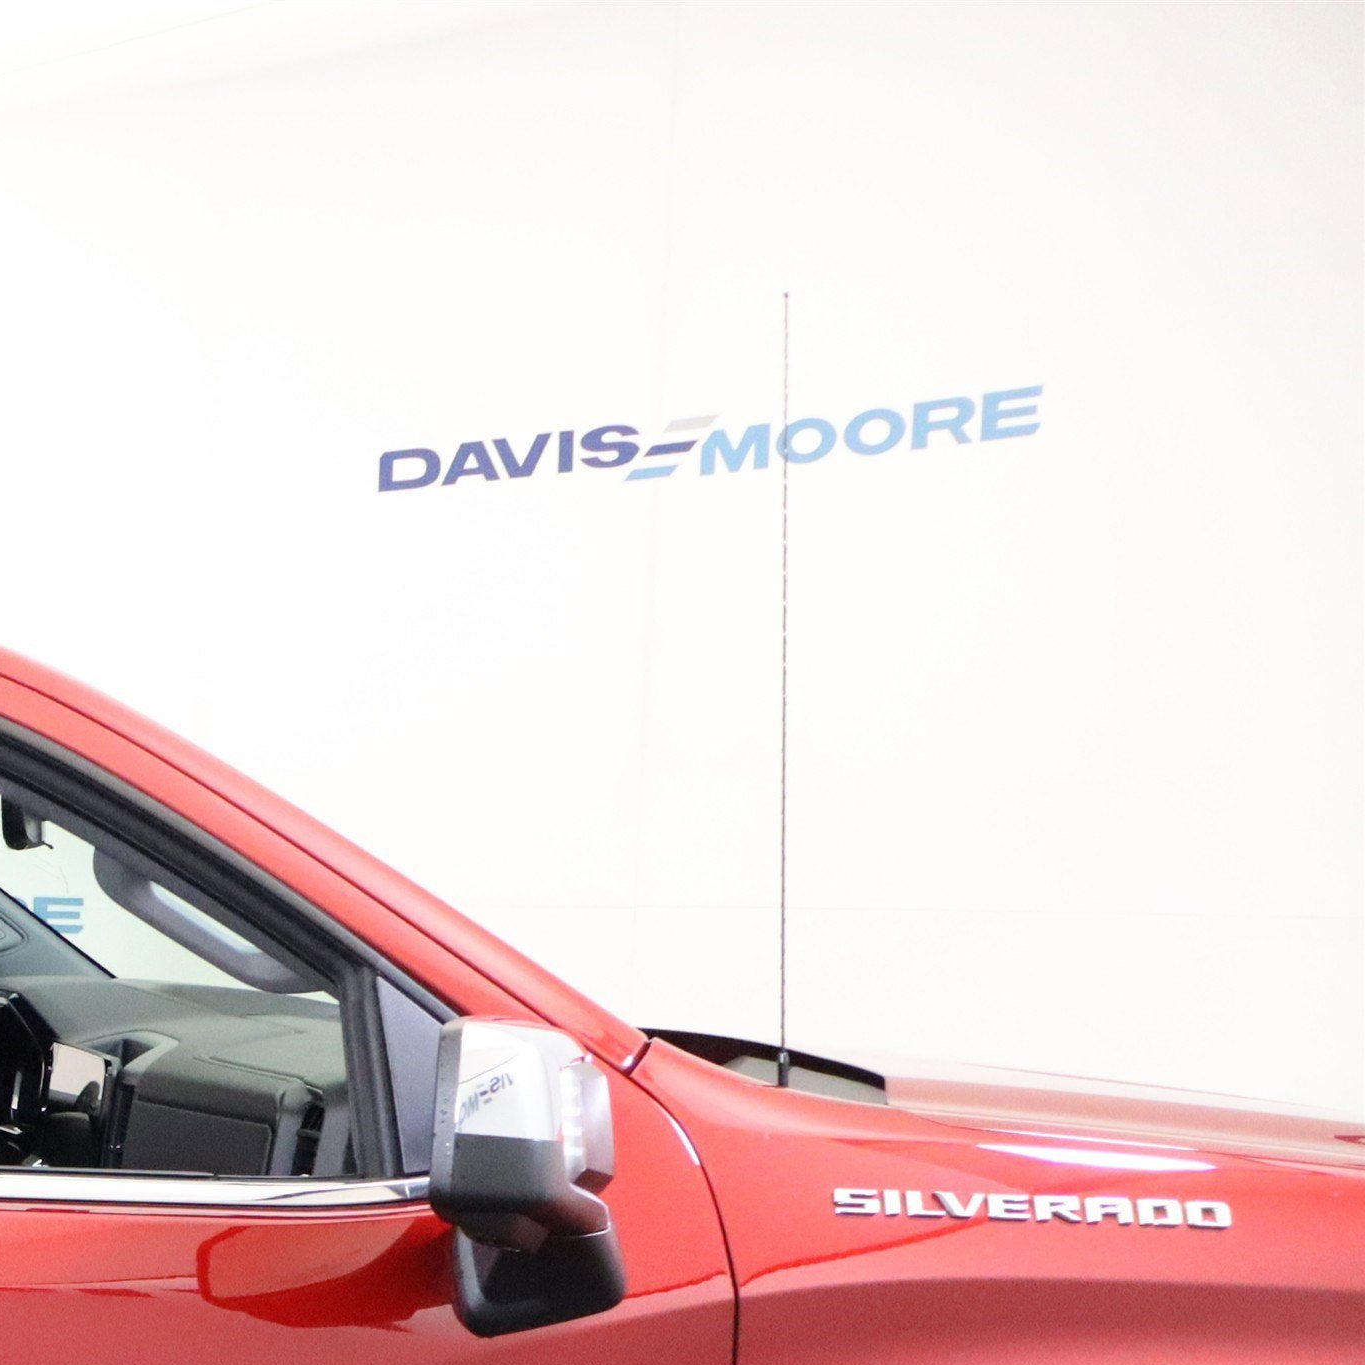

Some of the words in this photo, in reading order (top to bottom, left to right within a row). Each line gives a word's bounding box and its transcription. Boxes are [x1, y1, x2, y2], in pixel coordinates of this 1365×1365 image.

[378, 424, 642, 492] DAVIS
[699, 385, 1044, 477] MOORE
[833, 1187, 1232, 1230] SILVERADO
